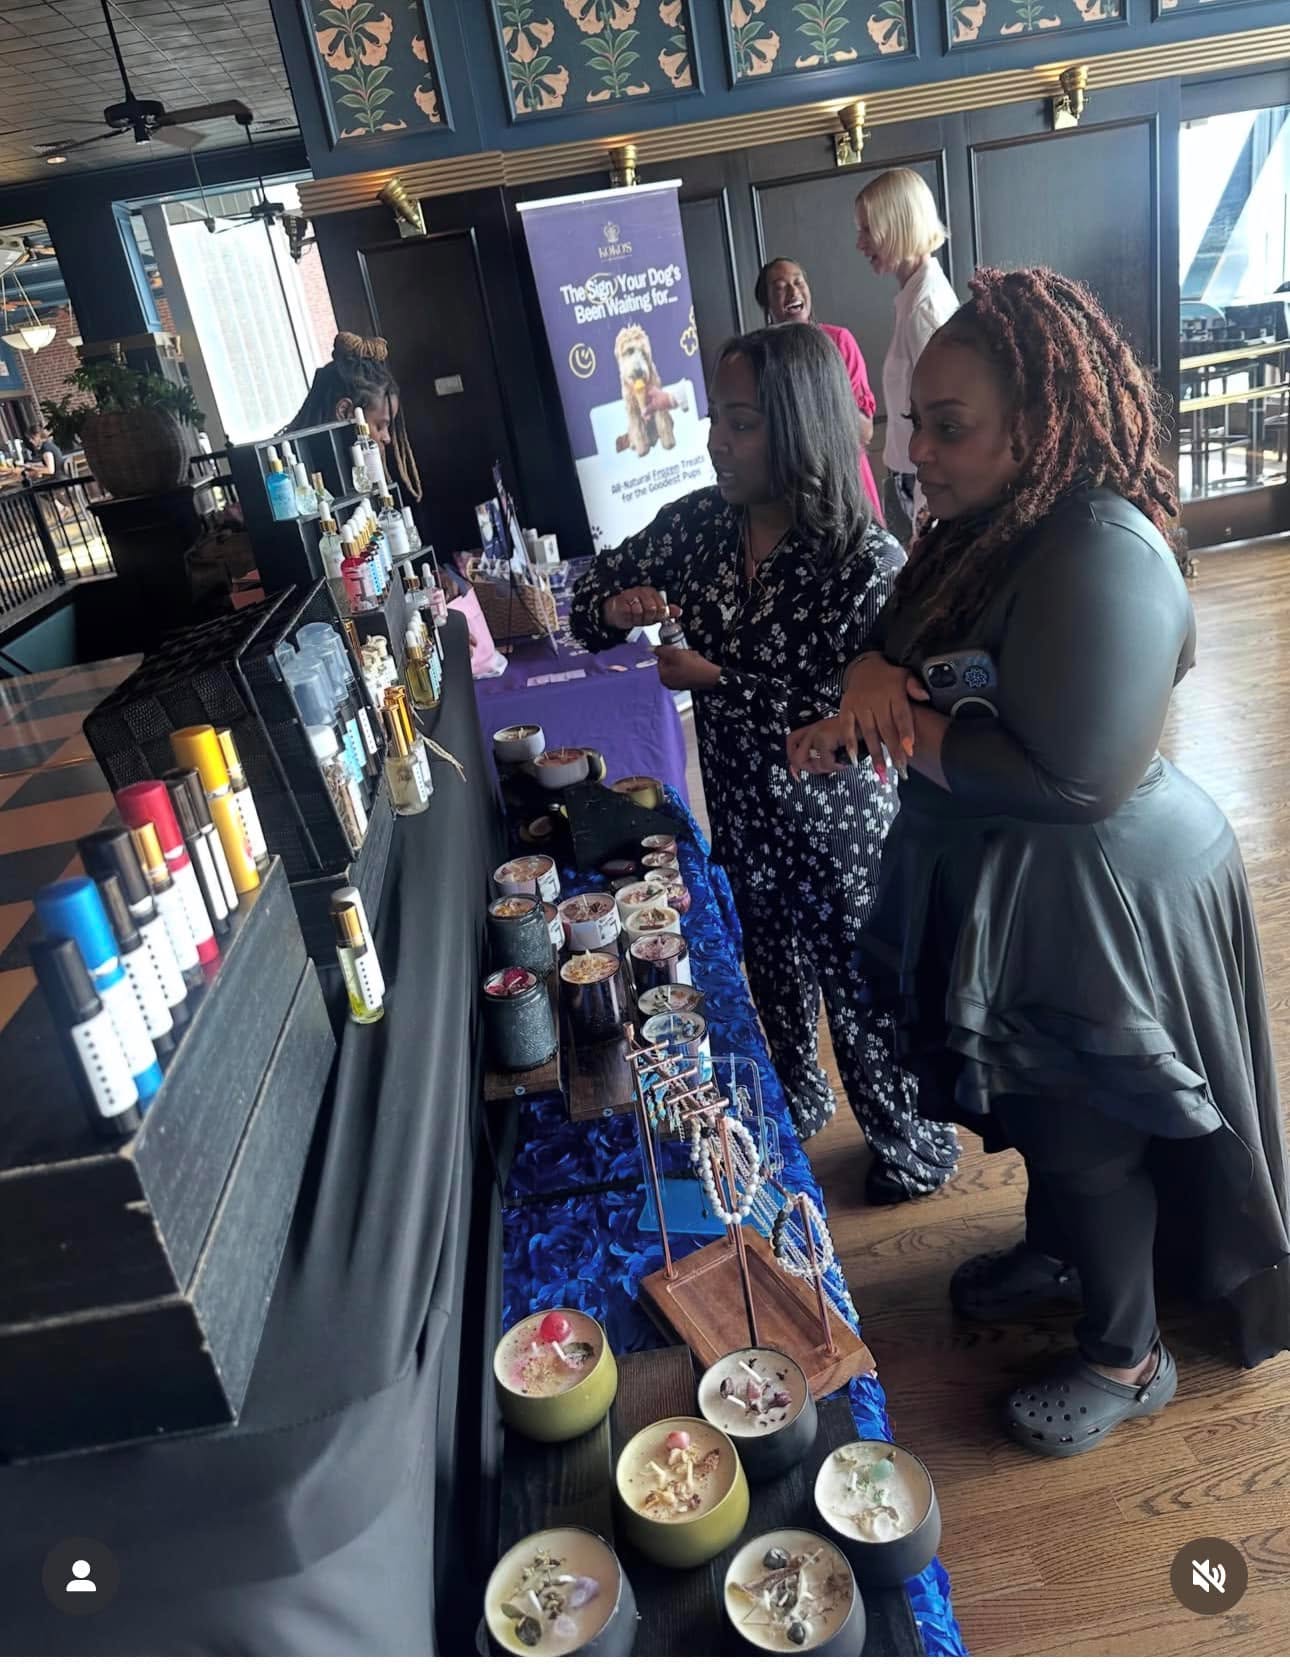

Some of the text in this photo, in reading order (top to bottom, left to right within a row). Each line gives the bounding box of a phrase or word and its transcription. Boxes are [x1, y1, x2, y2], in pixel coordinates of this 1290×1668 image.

[560, 264, 682, 304] The Sign Your Dog's
[574, 305, 606, 325] Been
[606, 292, 653, 316] Waiting
[611, 455, 705, 494] All-Natural Frozen Treats
[621, 492, 633, 502] for
[634, 486, 648, 498] the
[648, 475, 681, 493] Goodest
